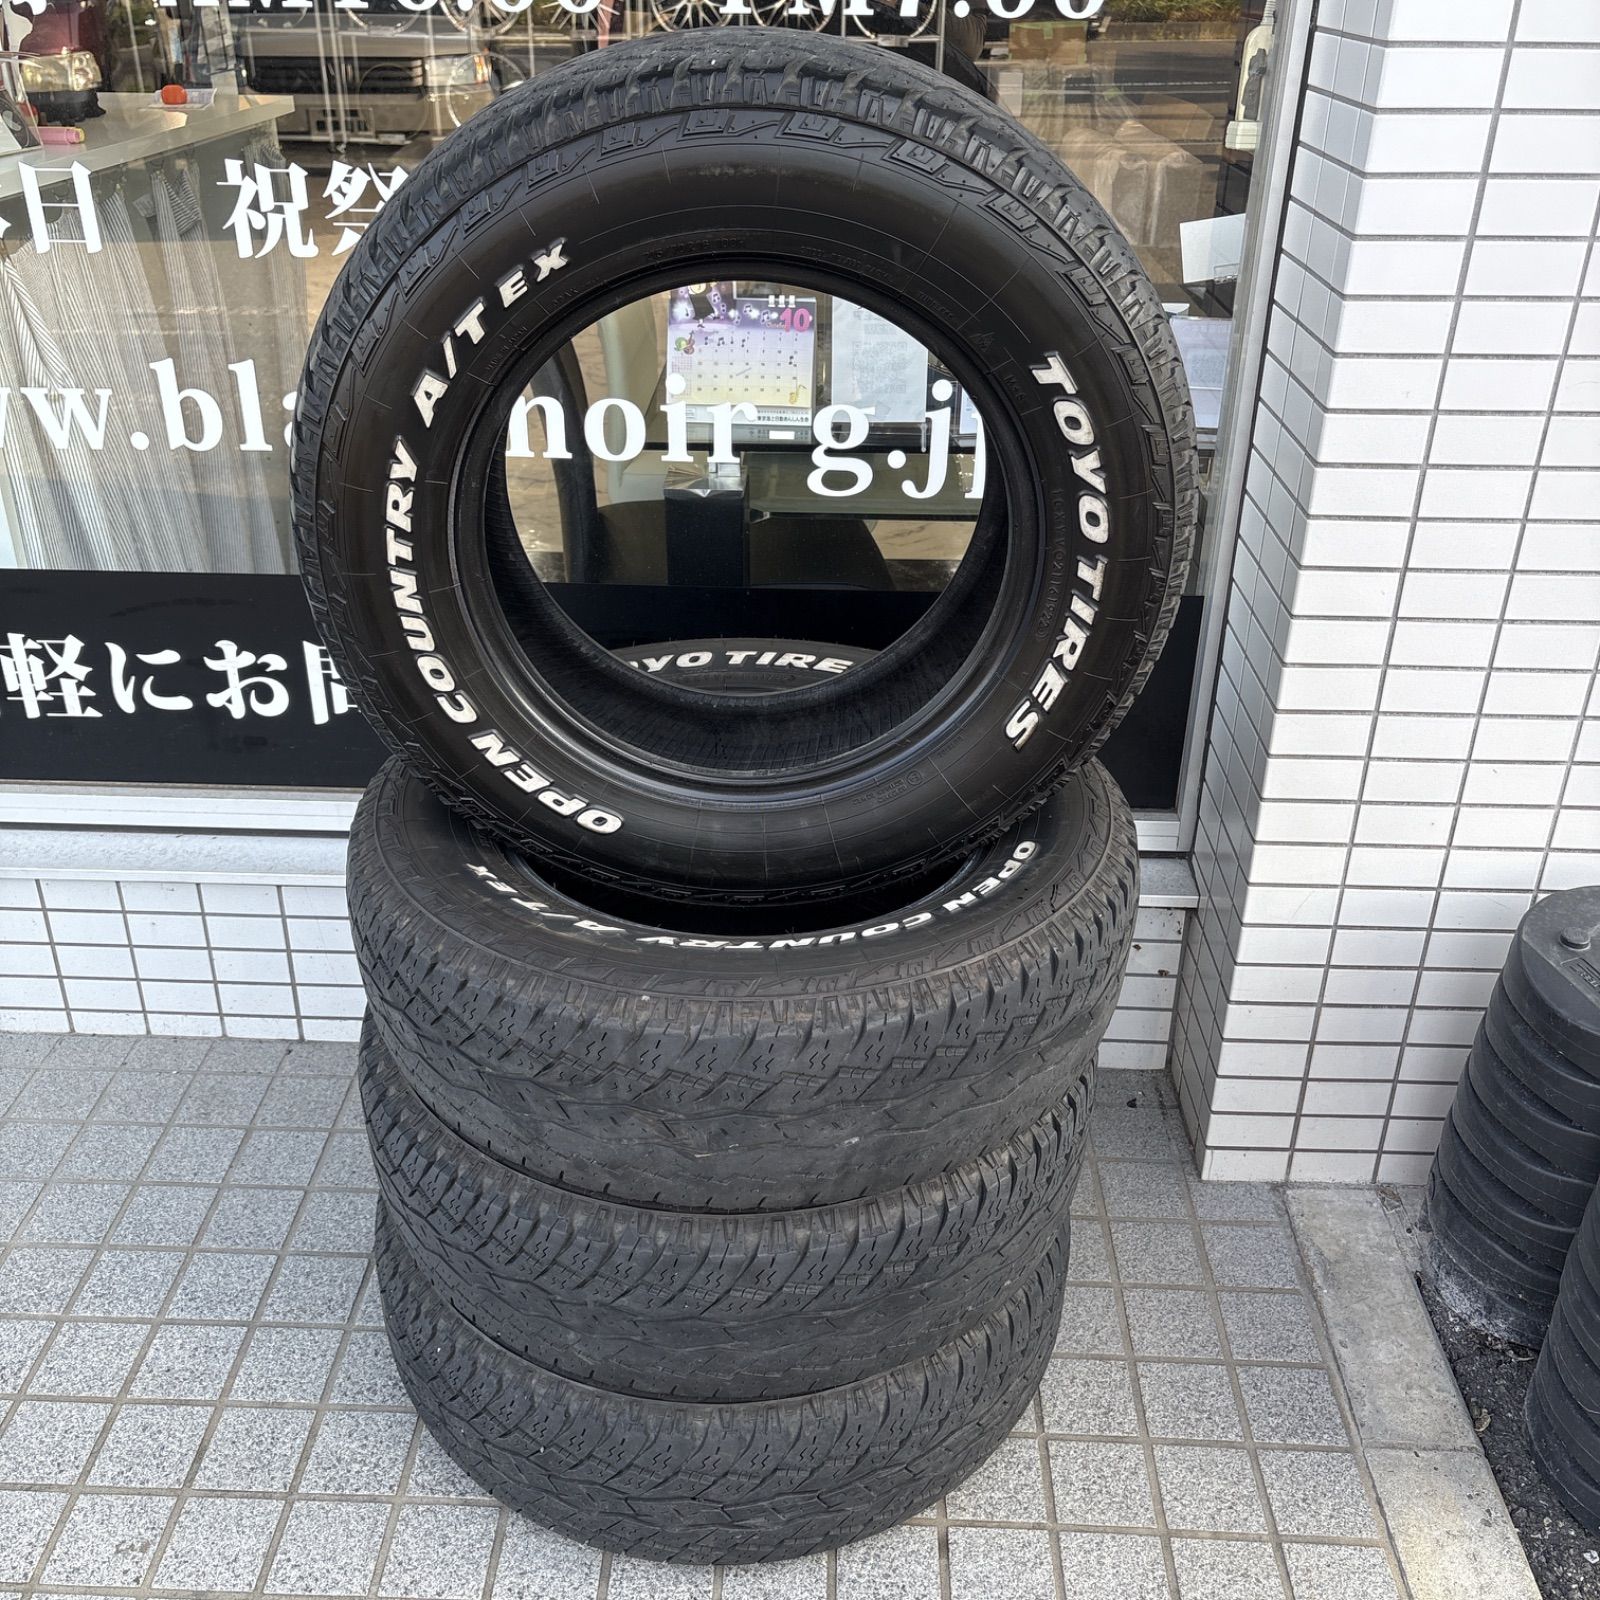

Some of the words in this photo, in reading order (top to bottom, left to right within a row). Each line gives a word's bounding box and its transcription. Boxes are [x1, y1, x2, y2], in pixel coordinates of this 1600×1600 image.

[0, 160, 103, 254] 日
[498, 243, 568, 308] EX
[780, 308, 811, 332] 10
[0, 357, 297, 452] w.bl
[413, 302, 485, 428] A/T
[1031, 351, 1109, 544] TOYO
[386, 436, 478, 724] COUNTRY
[725, 650, 854, 674] TIRE
[1005, 560, 1105, 747] TIRES
[470, 730, 624, 834] OPEN
[942, 841, 1036, 913] OPEN
[635, 911, 933, 950] COUNTRY
